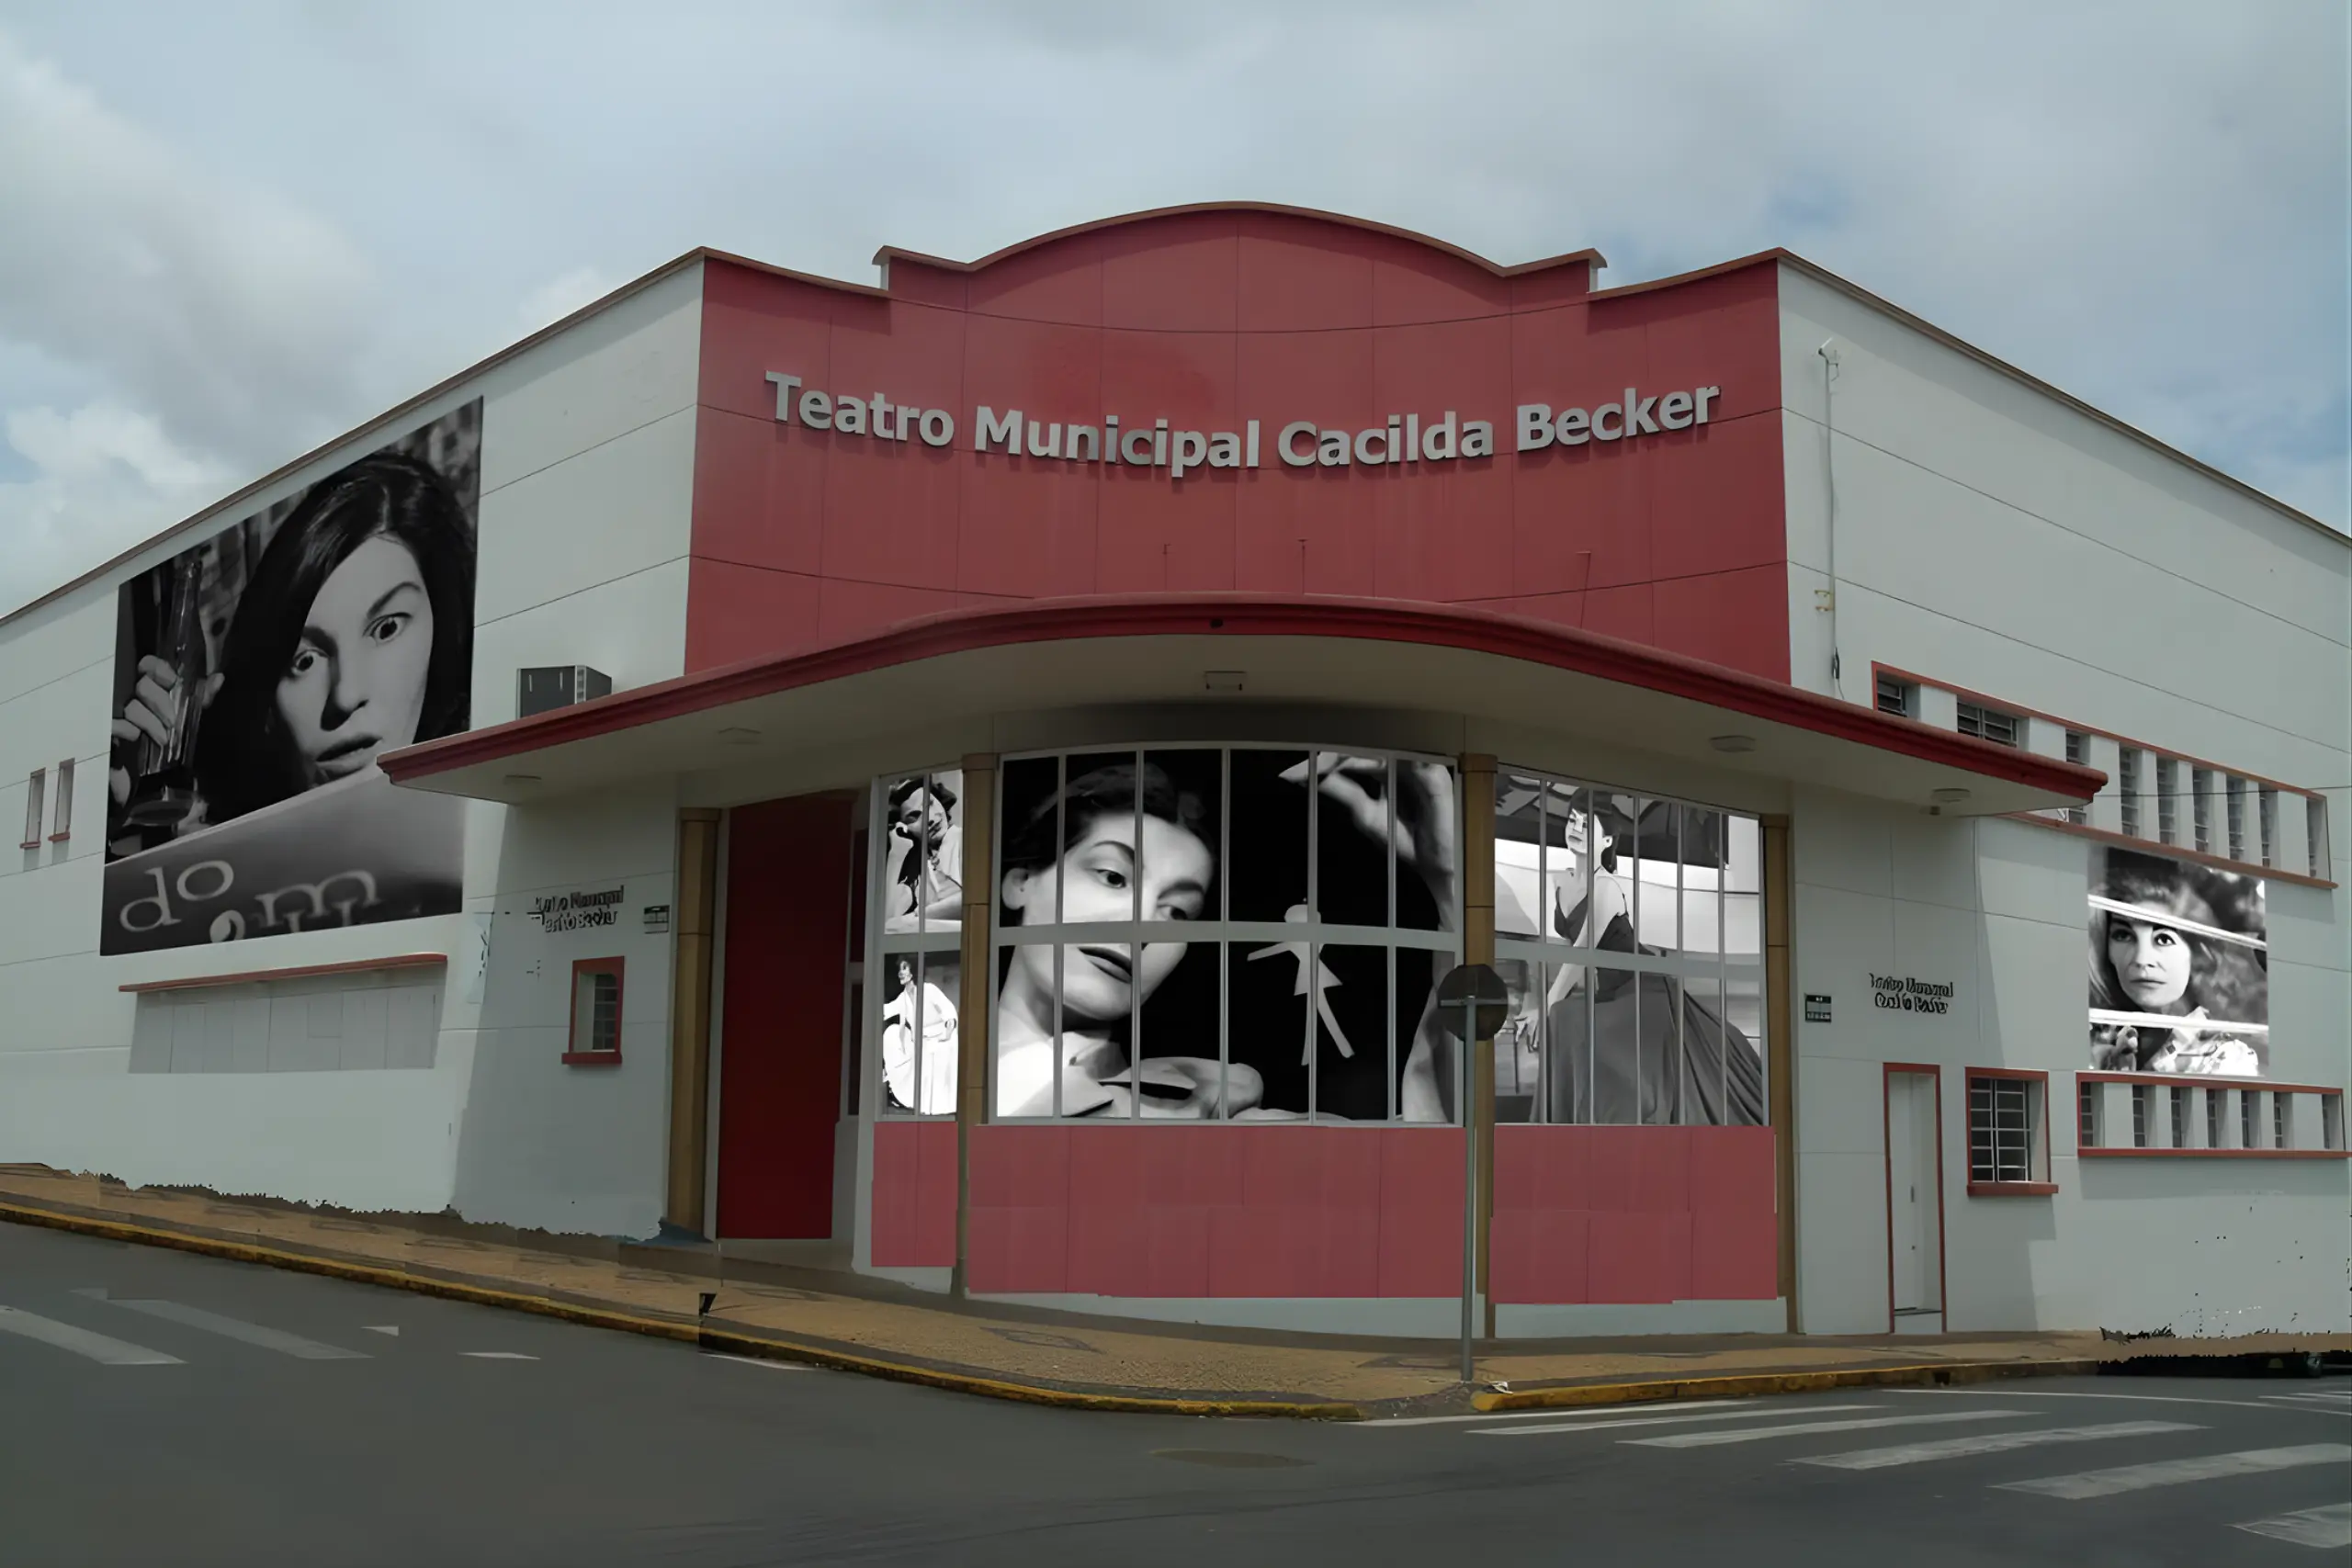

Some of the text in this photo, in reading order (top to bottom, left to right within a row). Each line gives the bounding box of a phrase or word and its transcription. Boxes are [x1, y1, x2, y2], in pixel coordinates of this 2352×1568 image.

[764, 369, 1721, 478] Teatro Municipal Cacilda Becker
[119, 860, 234, 932] do
